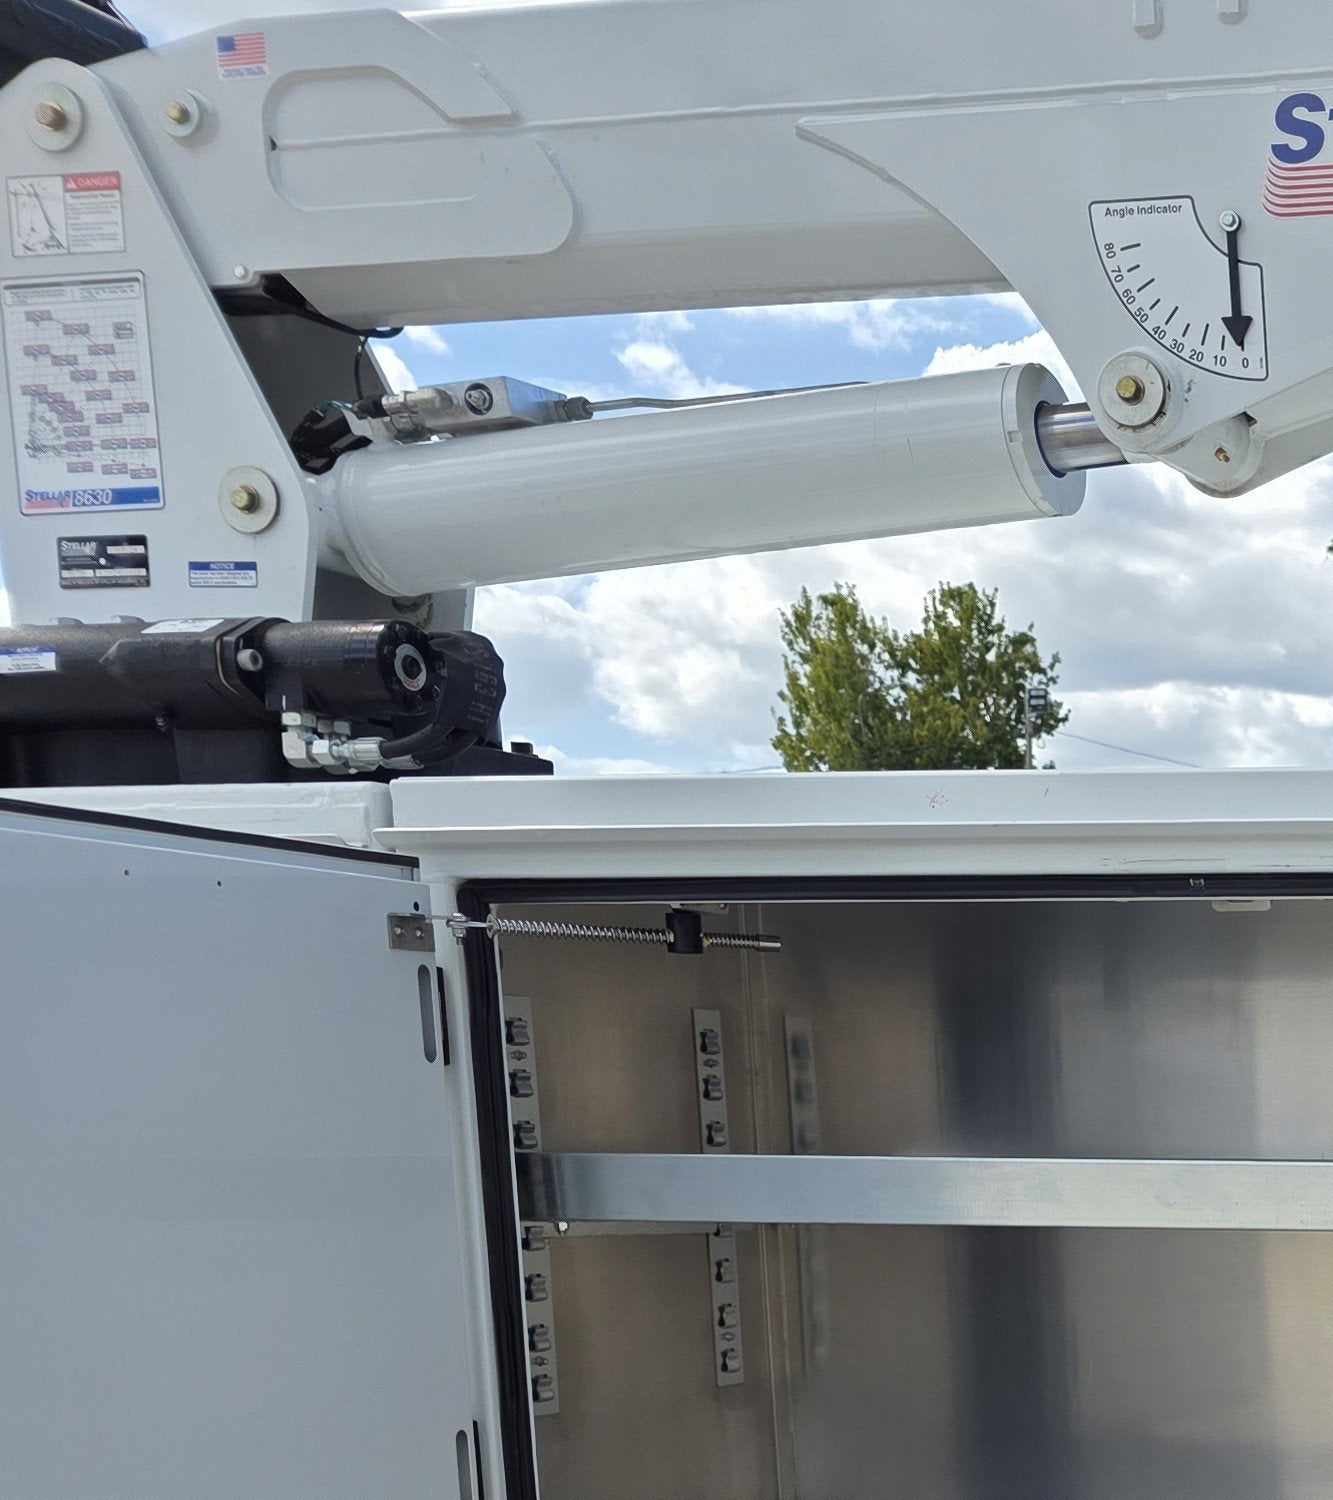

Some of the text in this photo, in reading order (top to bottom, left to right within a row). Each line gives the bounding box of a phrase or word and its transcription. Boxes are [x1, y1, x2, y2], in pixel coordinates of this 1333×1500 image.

[1104, 203, 1183, 219] Angle Indicator
[1104, 242, 1117, 259] 80
[1110, 265, 1124, 283] 70
[1121, 288, 1136, 305] 60
[1133, 307, 1149, 324] 50
[1151, 325, 1167, 340] 40
[1169, 338, 1185, 354] 30
[1188, 349, 1204, 363] 20
[1212, 355, 1227, 368] 10
[1241, 357, 1250, 369] 0
[25, 488, 113, 506] STELLAR 8630
[209, 562, 235, 570] NOTICE
